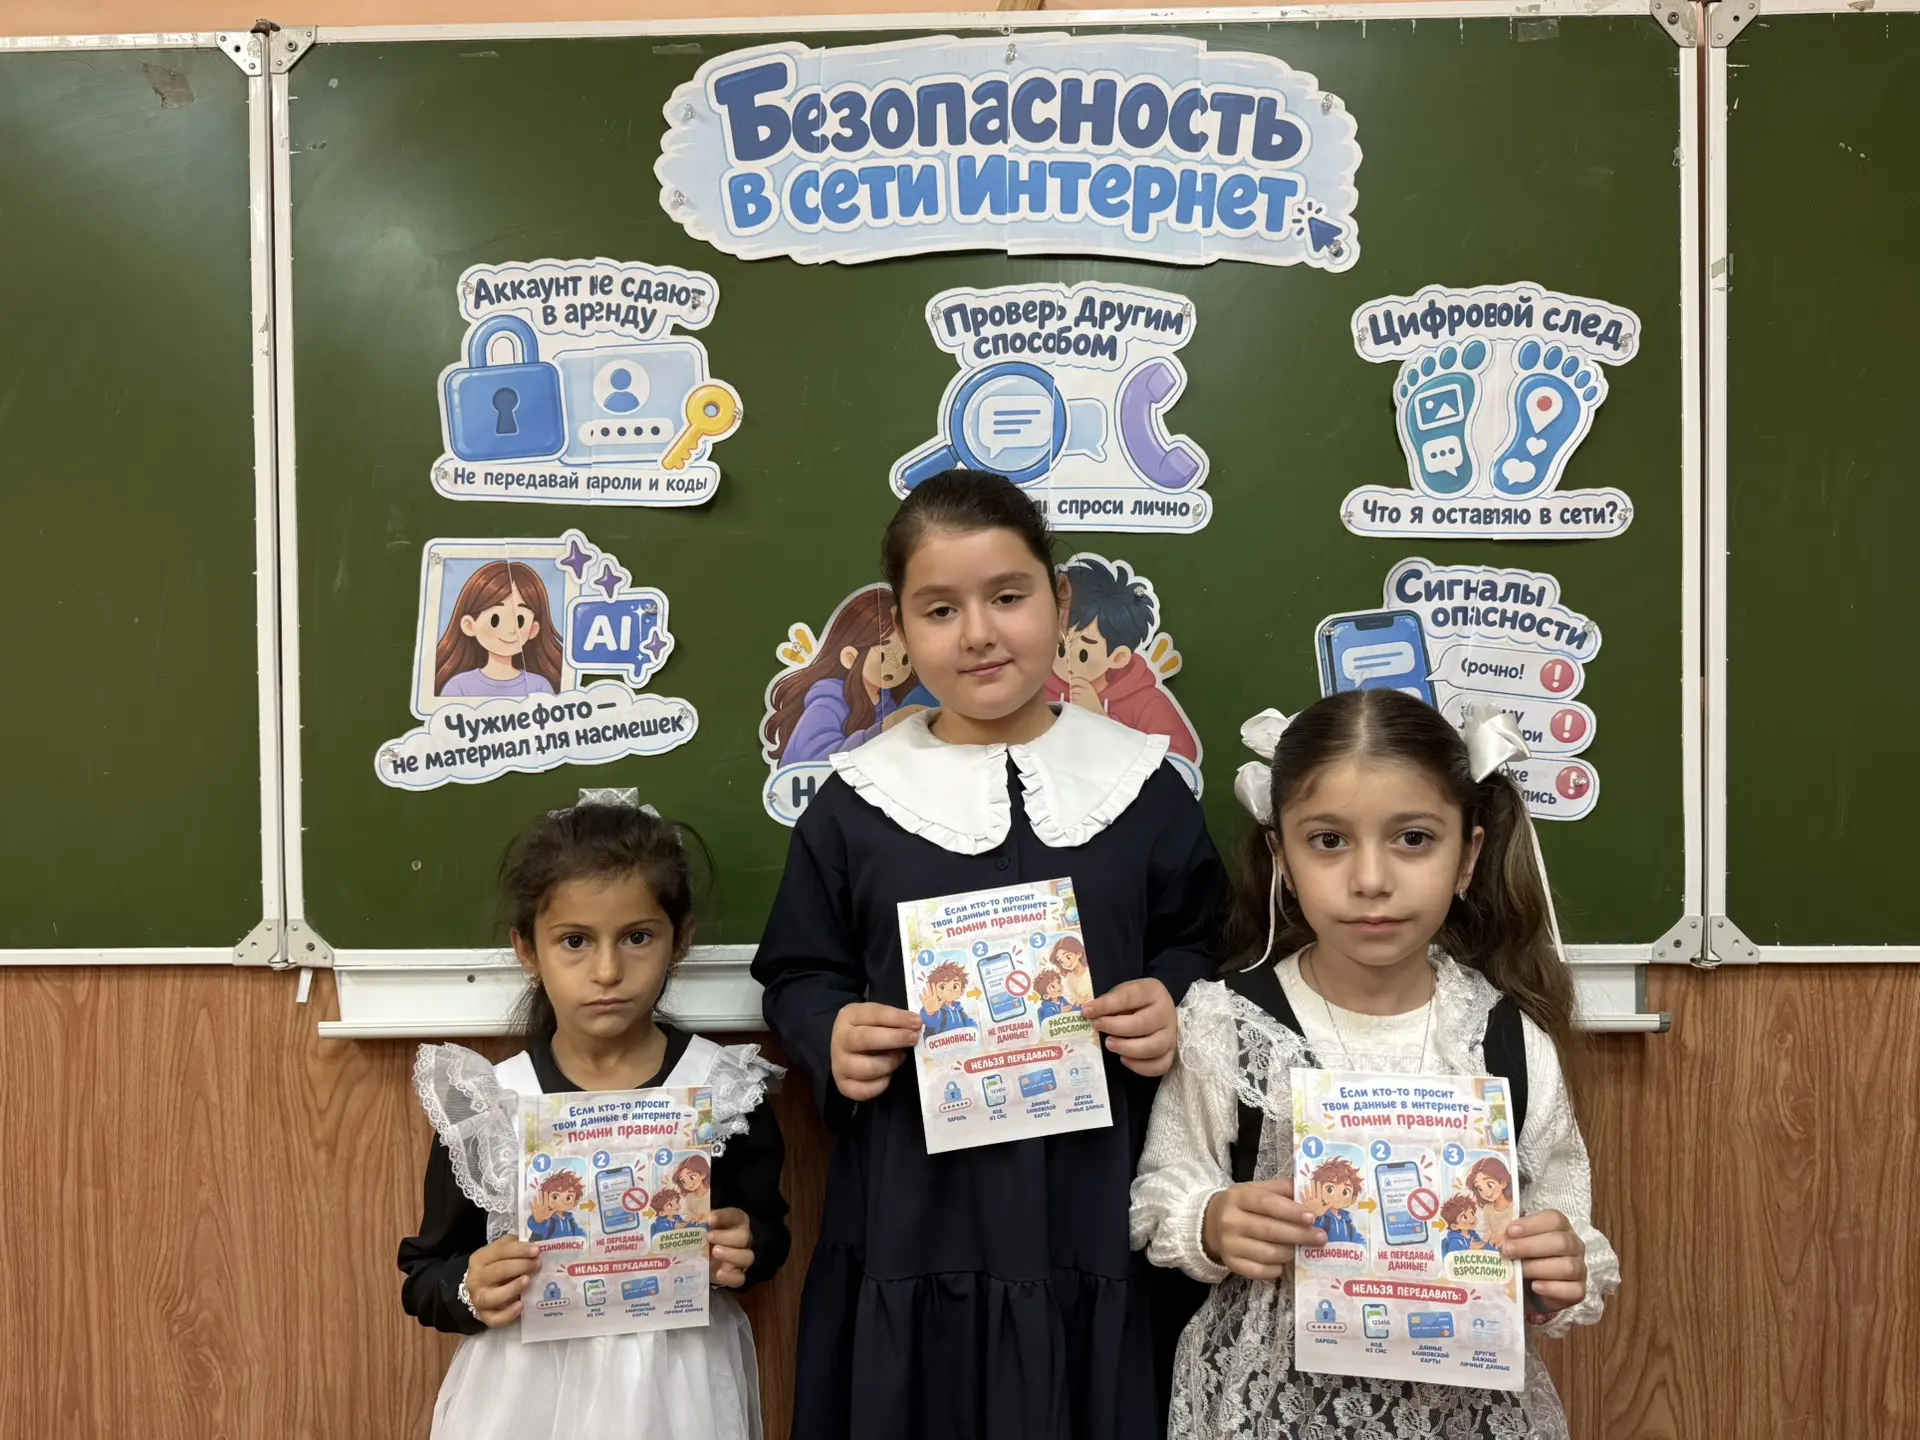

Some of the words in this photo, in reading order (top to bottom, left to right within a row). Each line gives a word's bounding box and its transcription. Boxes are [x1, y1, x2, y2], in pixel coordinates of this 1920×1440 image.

[714, 62, 1302, 162] Безопасность
[728, 171, 772, 229] в
[797, 163, 938, 225] сети
[958, 156, 1299, 234] Интернет
[474, 275, 582, 310] Аккаунт
[543, 305, 557, 325] в
[1074, 296, 1184, 335] Другим
[1369, 296, 1533, 346] Цифровой
[1542, 306, 1623, 351] след
[974, 327, 1117, 361] способом
[453, 468, 476, 485] Не
[484, 470, 579, 492] передавай
[649, 476, 659, 491] и
[666, 475, 708, 493] коды
[1057, 500, 1123, 519] спроси
[1131, 499, 1190, 517] лично
[1363, 499, 1400, 523] Что
[1409, 506, 1423, 523] я
[1540, 507, 1552, 525] в
[1560, 501, 1618, 525] сети?
[1396, 569, 1546, 607] Сигналы
[583, 615, 632, 651] AI
[1431, 606, 1588, 651] опасности
[392, 755, 419, 775] не
[425, 738, 530, 769] материал
[575, 714, 684, 745] насмешек
[944, 904, 968, 916] Если
[970, 899, 1000, 910] кто-то
[1003, 893, 1035, 905] просит
[931, 917, 953, 929] твои
[956, 909, 991, 924] данные
[993, 907, 999, 915] в
[1001, 901, 1048, 913] интернете
[991, 909, 1047, 928] правило!
[1034, 935, 1042, 946] 3
[976, 944, 985, 954] 2
[923, 953, 929, 963] 1
[988, 1028, 997, 1036] НЕ
[997, 1020, 1034, 1035] ПЕРЕДАВАЙ
[929, 1032, 977, 1049] ОСТАНОВИСЬ!
[997, 1031, 1029, 1044] ДАННЫЕ!
[972, 1056, 1005, 1071] НЕЛЬЗЯ
[1007, 1049, 1059, 1064] ПЕРЕДАВАТЬ:
[1340, 1087, 1367, 1099] Если
[1372, 1087, 1410, 1097] кто-то
[1414, 1088, 1454, 1099] просит
[569, 1106, 595, 1118] Если
[598, 1102, 632, 1113] кто-то
[635, 1100, 670, 1110] просит
[1322, 1102, 1349, 1112] твои
[1353, 1101, 1397, 1112] данные
[1401, 1101, 1407, 1109] в
[1412, 1101, 1469, 1113] интернете
[552, 1120, 577, 1132] твои
[580, 1115, 619, 1128] данные
[622, 1113, 628, 1121] в
[631, 1111, 681, 1122] интернете
[1397, 1113, 1468, 1130] правило!
[617, 1121, 679, 1139] правило!
[1308, 1140, 1317, 1154] 1
[1376, 1144, 1386, 1158] 2
[1448, 1148, 1458, 1161] 3
[538, 1157, 545, 1169] 1
[597, 1154, 606, 1165] 2
[659, 1151, 668, 1163] 3
[596, 1238, 606, 1247] НЕ
[606, 1233, 645, 1245] ПЕРЕДАВАЙ
[659, 1238, 703, 1251] ВЗРОСЛОМУ!
[660, 1231, 701, 1242] РАССКАЖИ
[538, 1241, 584, 1253] СТАНОВИСЬ!
[604, 1243, 638, 1254] ДАННЫЕ!
[1304, 1248, 1363, 1262] ОСТАНОВИСЬ!
[1377, 1251, 1389, 1260] НЕ
[1390, 1250, 1435, 1262] ПЕРЕДАВАЙ
[1454, 1255, 1502, 1266] РАССКАЖИ
[575, 1264, 610, 1275] НЕЛЬЗЯ
[613, 1260, 665, 1272] ПЕРЕДАВАТЬ:
[1388, 1261, 1428, 1272] ДАННЫЕ!
[1454, 1266, 1507, 1278] ВЗРОСЛОМУ!
[1352, 1283, 1394, 1296] НЕЛЬЗЯ
[1397, 1286, 1462, 1300] ПЕРЕДАВАТЬ:
[1412, 1350, 1449, 1359] БАНКОВСКОЙ
